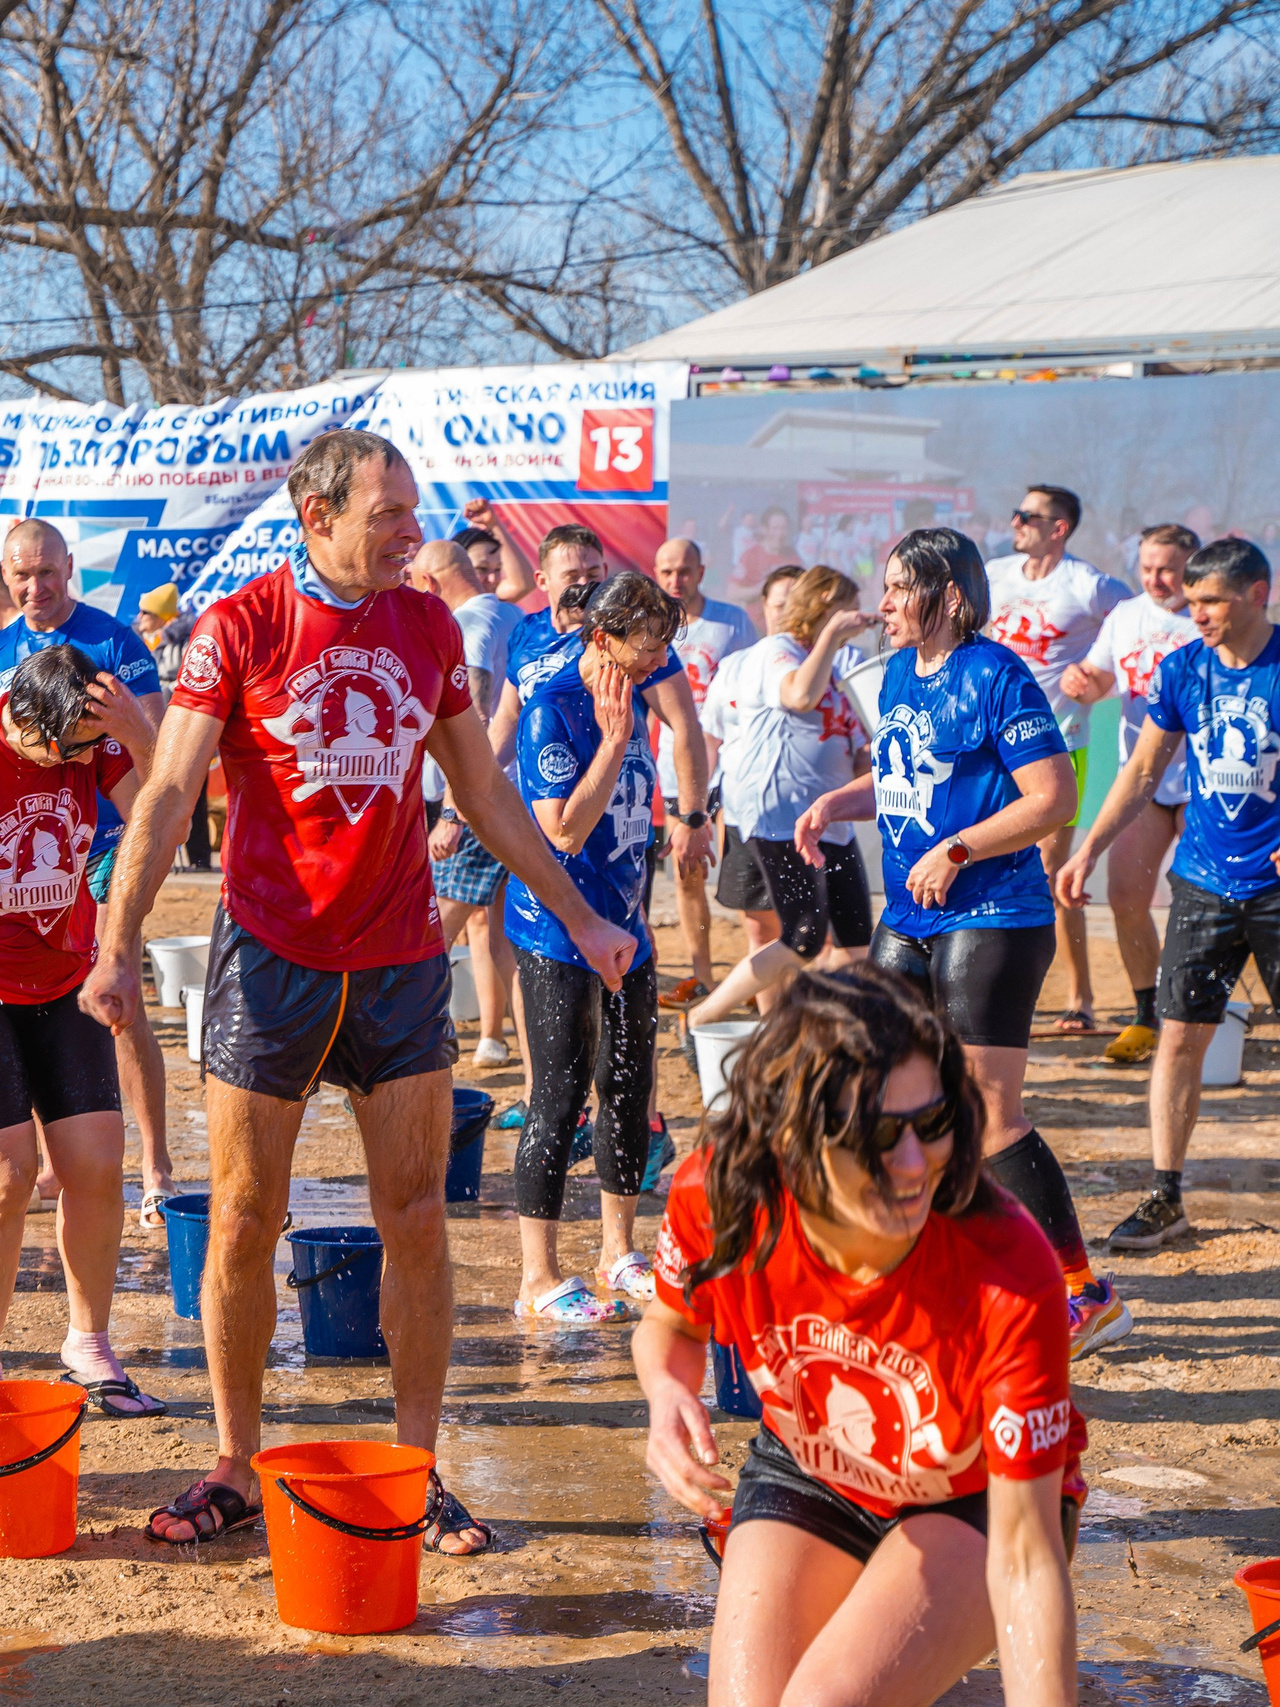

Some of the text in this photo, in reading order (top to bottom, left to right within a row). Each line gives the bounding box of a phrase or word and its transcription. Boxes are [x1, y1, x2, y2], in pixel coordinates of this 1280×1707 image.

[3, 410, 163, 434] МЖДУНАРОНАЯ
[569, 381, 656, 402] АКЦИЯ
[408, 412, 566, 447] ОДНО
[589, 425, 644, 473] 13
[75, 473, 154, 488] 80-ЕТИЮ
[159, 468, 238, 487] ПОБЕДЫ
[244, 468, 257, 483] В
[137, 527, 273, 559] МАССООЕ
[169, 552, 288, 582] ХООДНО
[1018, 716, 1047, 732] ПУТЬ
[312, 748, 401, 777] ЯРОПОЛК
